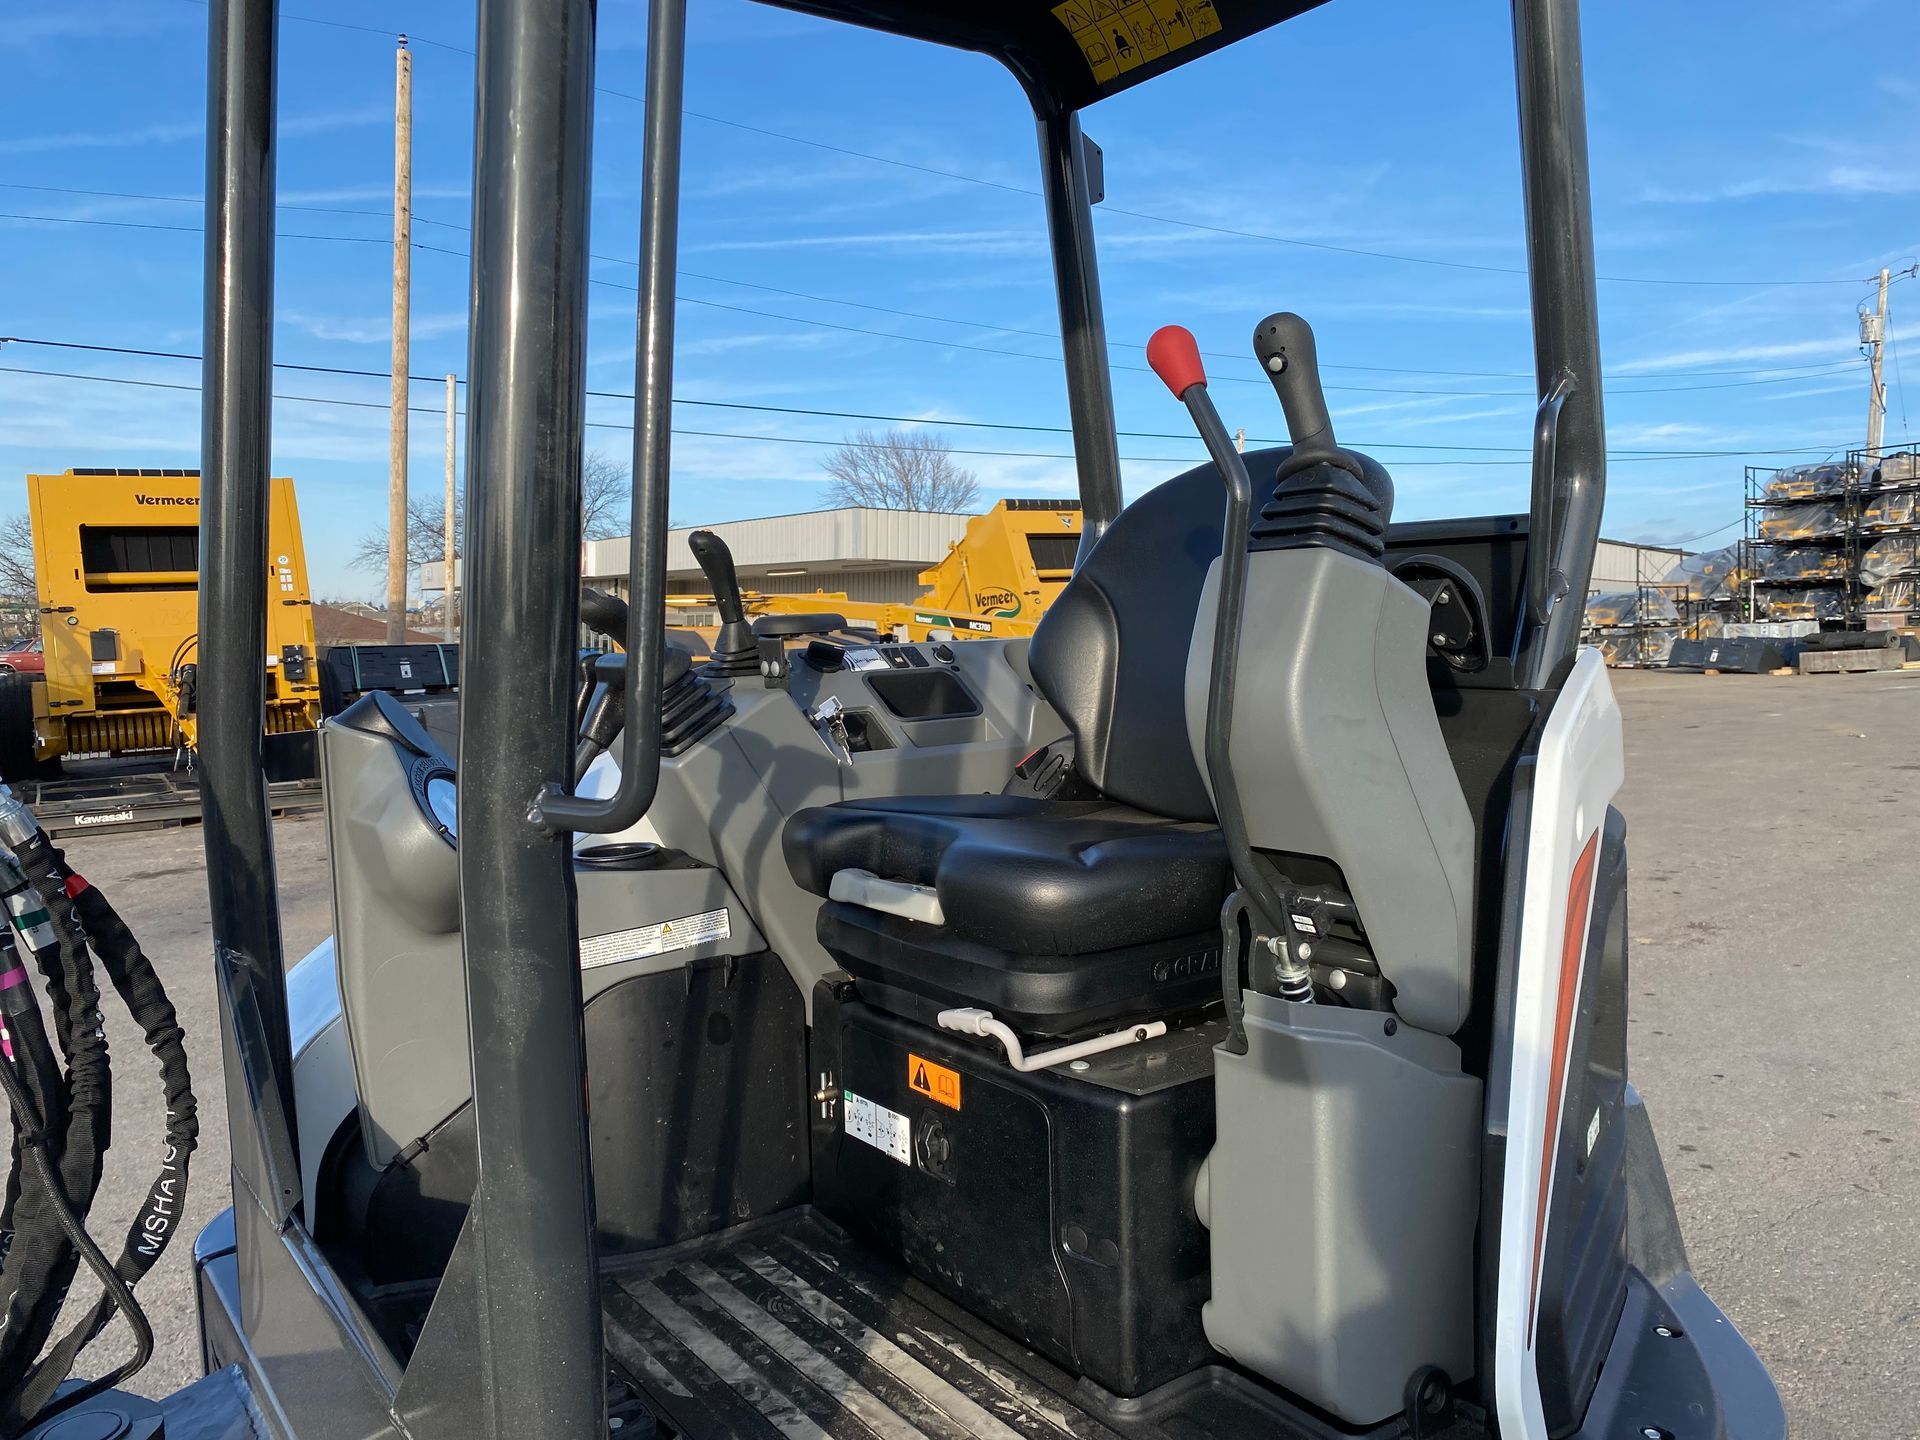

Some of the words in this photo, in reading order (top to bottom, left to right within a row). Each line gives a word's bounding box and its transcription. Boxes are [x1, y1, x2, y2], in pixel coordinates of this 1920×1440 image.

[134, 494, 200, 505] Vermeer
[975, 592, 1014, 607] Vermeer
[969, 621, 991, 631] MC3700
[74, 810, 134, 825] Kawasaki
[137, 1178, 177, 1256] MSHA
